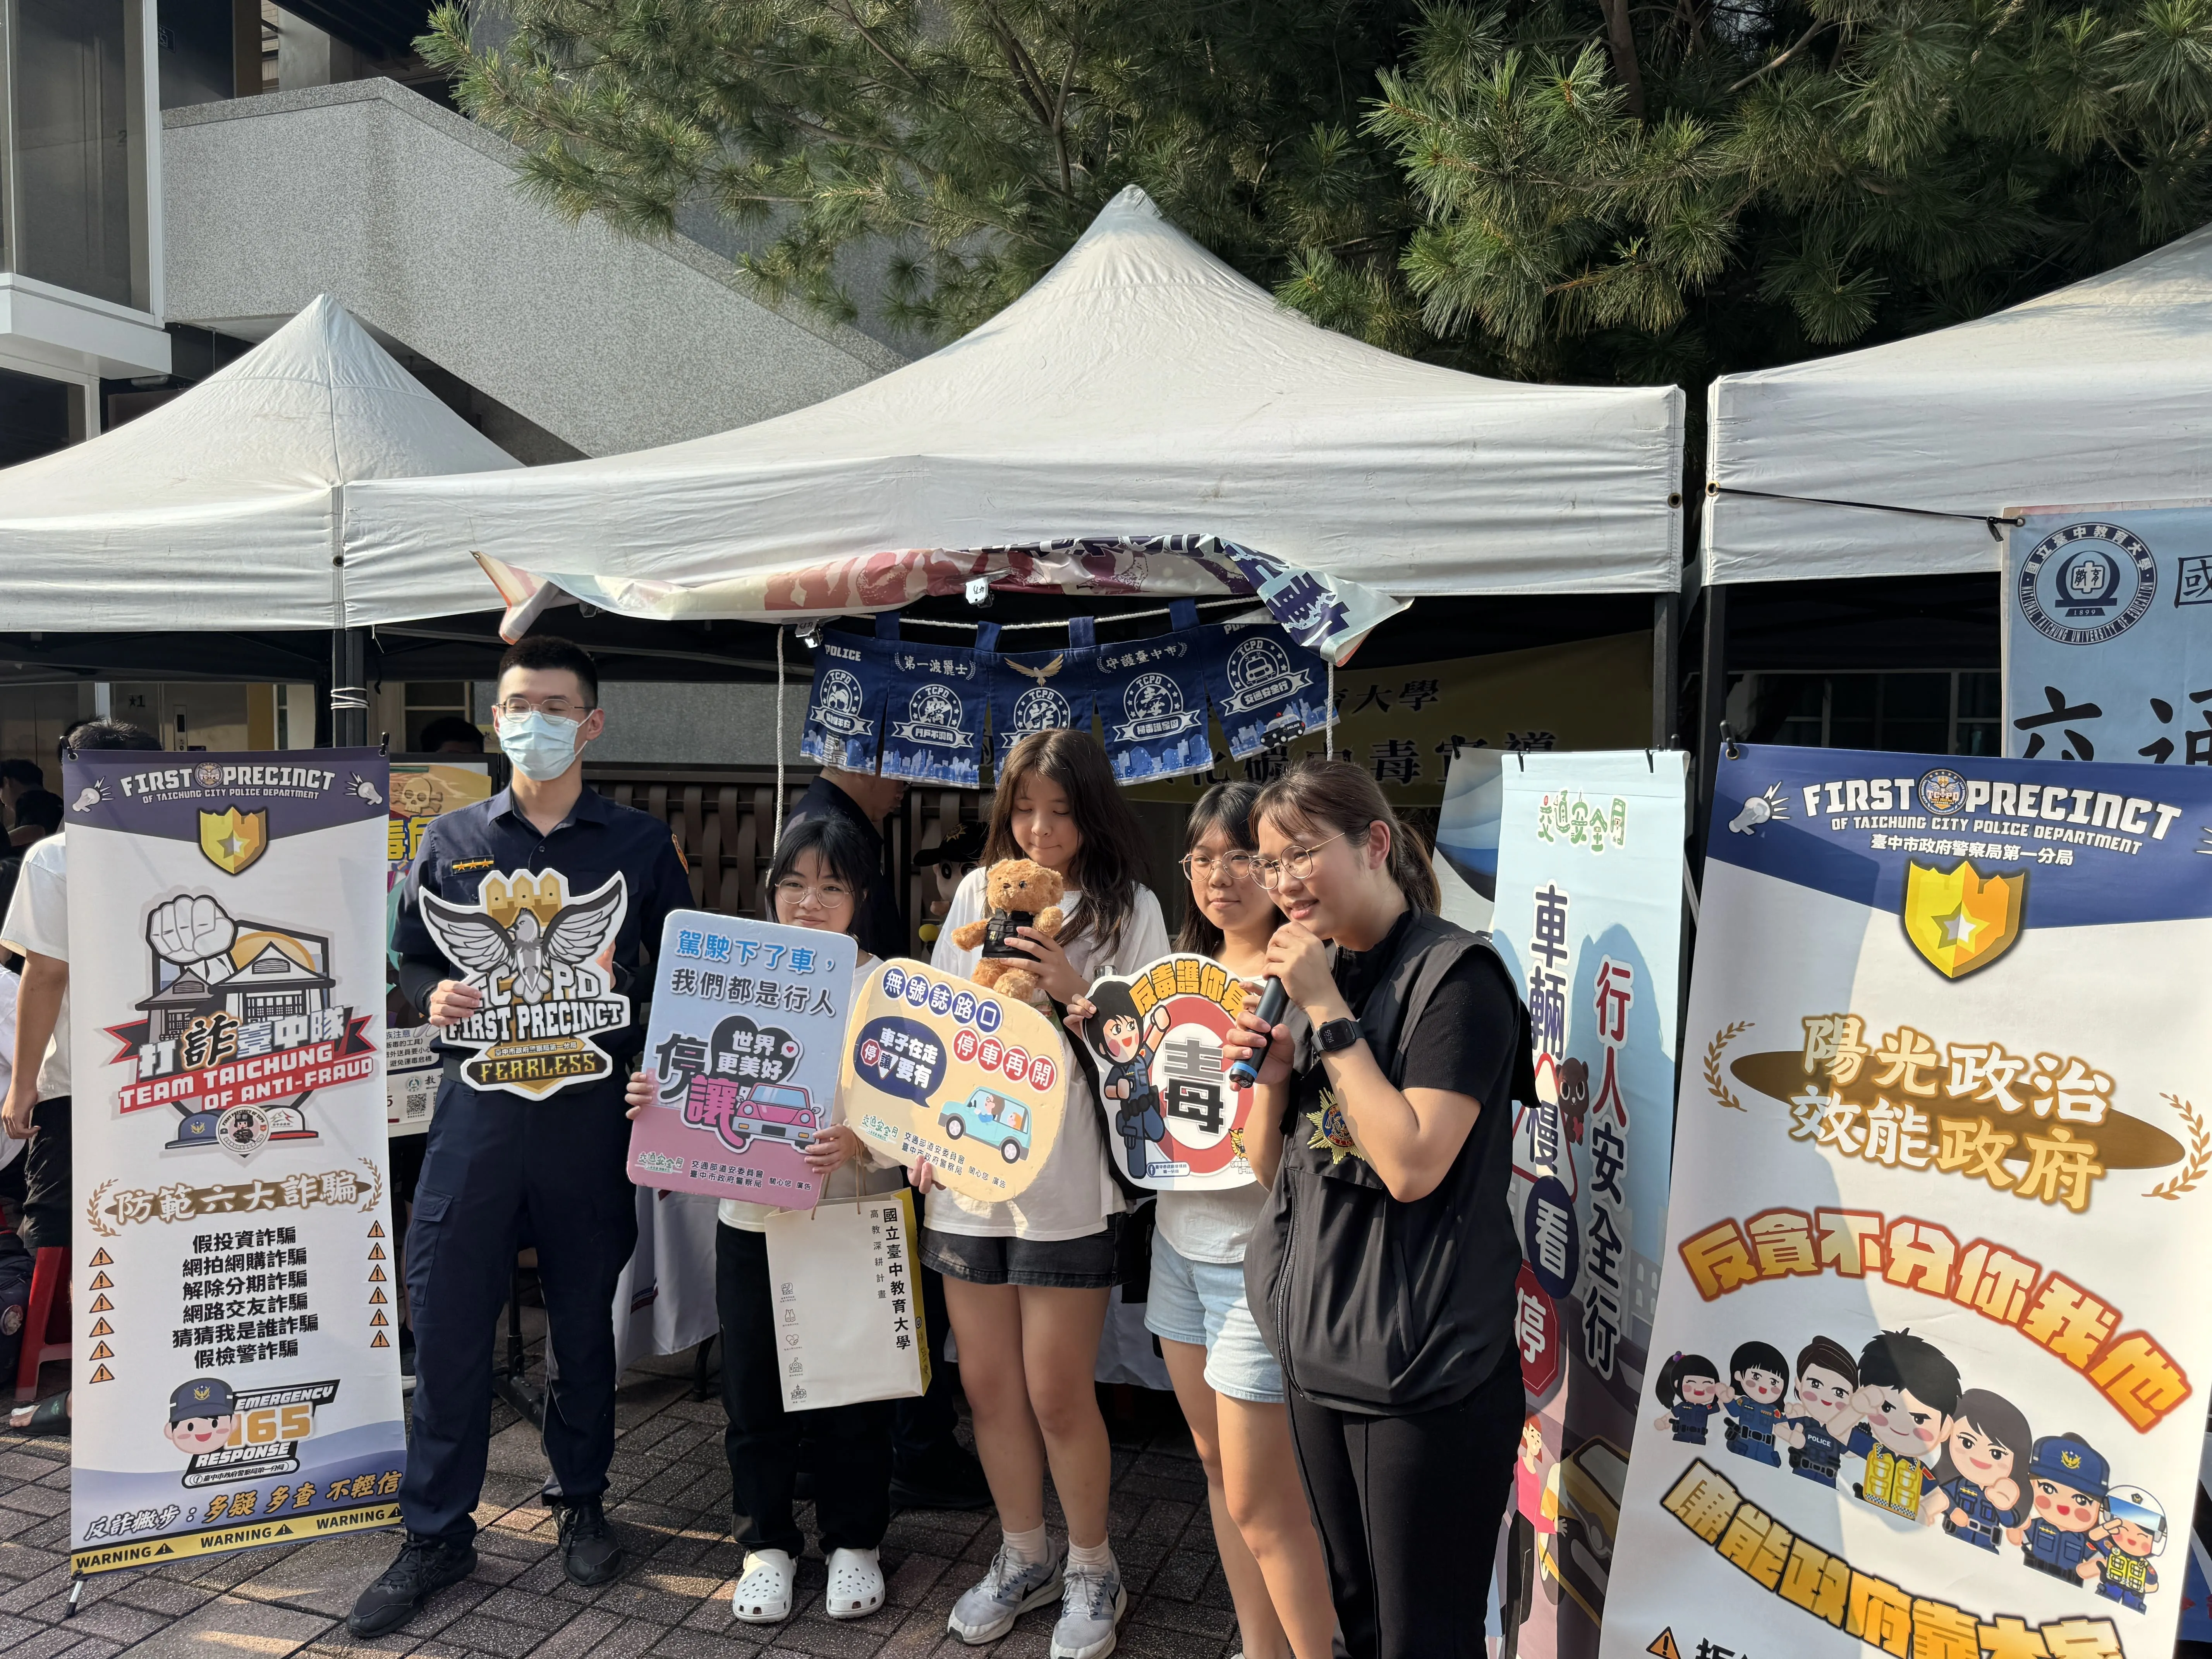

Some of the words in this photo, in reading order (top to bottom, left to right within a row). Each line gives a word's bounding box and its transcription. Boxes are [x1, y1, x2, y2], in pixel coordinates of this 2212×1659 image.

[2025, 526, 2152, 574] 國立臺中教育大學
[2021, 586, 2040, 618] NATIONAL
[2034, 616, 2068, 641] TAICHUNG
[2071, 623, 2117, 642] UNIVERSITY
[2117, 617, 2130, 629] OF
[2127, 582, 2154, 619] EDUCATION
[824, 644, 861, 661] POLICE
[1106, 646, 1177, 670] 守護臺中市
[1238, 640, 1263, 656] TCPD
[830, 672, 852, 684] TCPD
[904, 655, 968, 676] 第一波麗士
[1136, 675, 1162, 688] TCPD
[925, 687, 950, 698] TCPD
[1029, 690, 1054, 700] TCPD
[120, 768, 192, 797] FIRST
[223, 766, 335, 790] PRECINCT
[143, 795, 153, 804] OF
[156, 790, 202, 801] TAICHUNG
[205, 789, 226, 797] CITY
[263, 789, 319, 799] DEPARTMENT
[1538, 790, 1626, 852] 交通安全月
[1803, 778, 1915, 817] FIRST
[1965, 780, 2182, 840] PRECINCT
[1831, 818, 1847, 831] OF
[1853, 816, 1927, 830] TAICHUNG
[1932, 817, 1969, 832] CITY
[1973, 820, 2030, 836] POLICE
[2034, 825, 2143, 855] DEPARTMENT
[1871, 834, 2074, 866] 臺中市政府警察局第一分局
[676, 930, 836, 973] 駕駛下了車，
[551, 963, 600, 1000] PD
[670, 968, 836, 1016] 我們都是行人
[884, 970, 998, 1026] 無號誌路口
[449, 1007, 512, 1041] FIRST
[516, 1001, 622, 1039] PRECINCT
[138, 1005, 345, 1078] 打詐臺中隊
[495, 1041, 577, 1056] 臺中市政府警察局第一分局
[732, 1030, 775, 1056] 世界
[880, 1028, 938, 1065] 車子在走
[481, 1053, 596, 1082] FEARLESS
[716, 1051, 783, 1080] 更美好
[863, 1043, 932, 1088] 停讓要有
[956, 1031, 1054, 1087] 停車再開
[1804, 1016, 2110, 1123] 陽光政治
[119, 1077, 194, 1108] TEAM
[203, 1044, 333, 1089] TAICHUNG
[204, 1092, 233, 1110] OF
[241, 1058, 373, 1102] ANTI-FRAUD
[1164, 1038, 1224, 1136] 毒
[862, 1114, 898, 1138] 交通安全月
[638, 1151, 684, 1168] 交通安全月
[902, 1142, 962, 1176] 臺中市政府警察局
[904, 1131, 965, 1165] 交通部道安委員會
[1790, 1087, 2103, 1209] 效能政府
[689, 1170, 762, 1188] 臺中市政府警察局
[691, 1160, 764, 1178] 交通部道安委員會
[769, 1177, 792, 1187] 關心您
[796, 1182, 812, 1190] 廣告
[992, 1176, 1006, 1188] 廣告
[1585, 961, 1631, 1373] 行人安全行
[116, 1172, 356, 1223] 防範六大詐騙
[193, 1226, 296, 1254] 假投資詐騙
[870, 1209, 887, 1299] 高教深耕計畫
[182, 1247, 307, 1278] 網拍網購詐騙
[883, 1207, 910, 1350] 國立臺中教育大學
[183, 1270, 307, 1301] 解除分期詐騙
[183, 1292, 307, 1324] 網路交友詐騙
[1683, 1211, 2188, 1430] 反貪不分你我他
[172, 1314, 318, 1348] 猜猜我是誰詐騙
[194, 1339, 298, 1369] 假檢警詐騙
[235, 1385, 334, 1410] EMERGENCY
[227, 1405, 311, 1447] 165
[1808, 1434, 1831, 1447] POLICE
[195, 1442, 291, 1468] RESPONSE
[203, 1463, 285, 1482] 臺中市政府警察局第一分局
[202, 1490, 256, 1523] 多疑
[266, 1481, 316, 1514] 多查
[326, 1471, 402, 1501] 不輕信
[76, 1546, 151, 1568] WARNING
[201, 1527, 271, 1548] WARNING
[317, 1509, 385, 1530] WARNING
